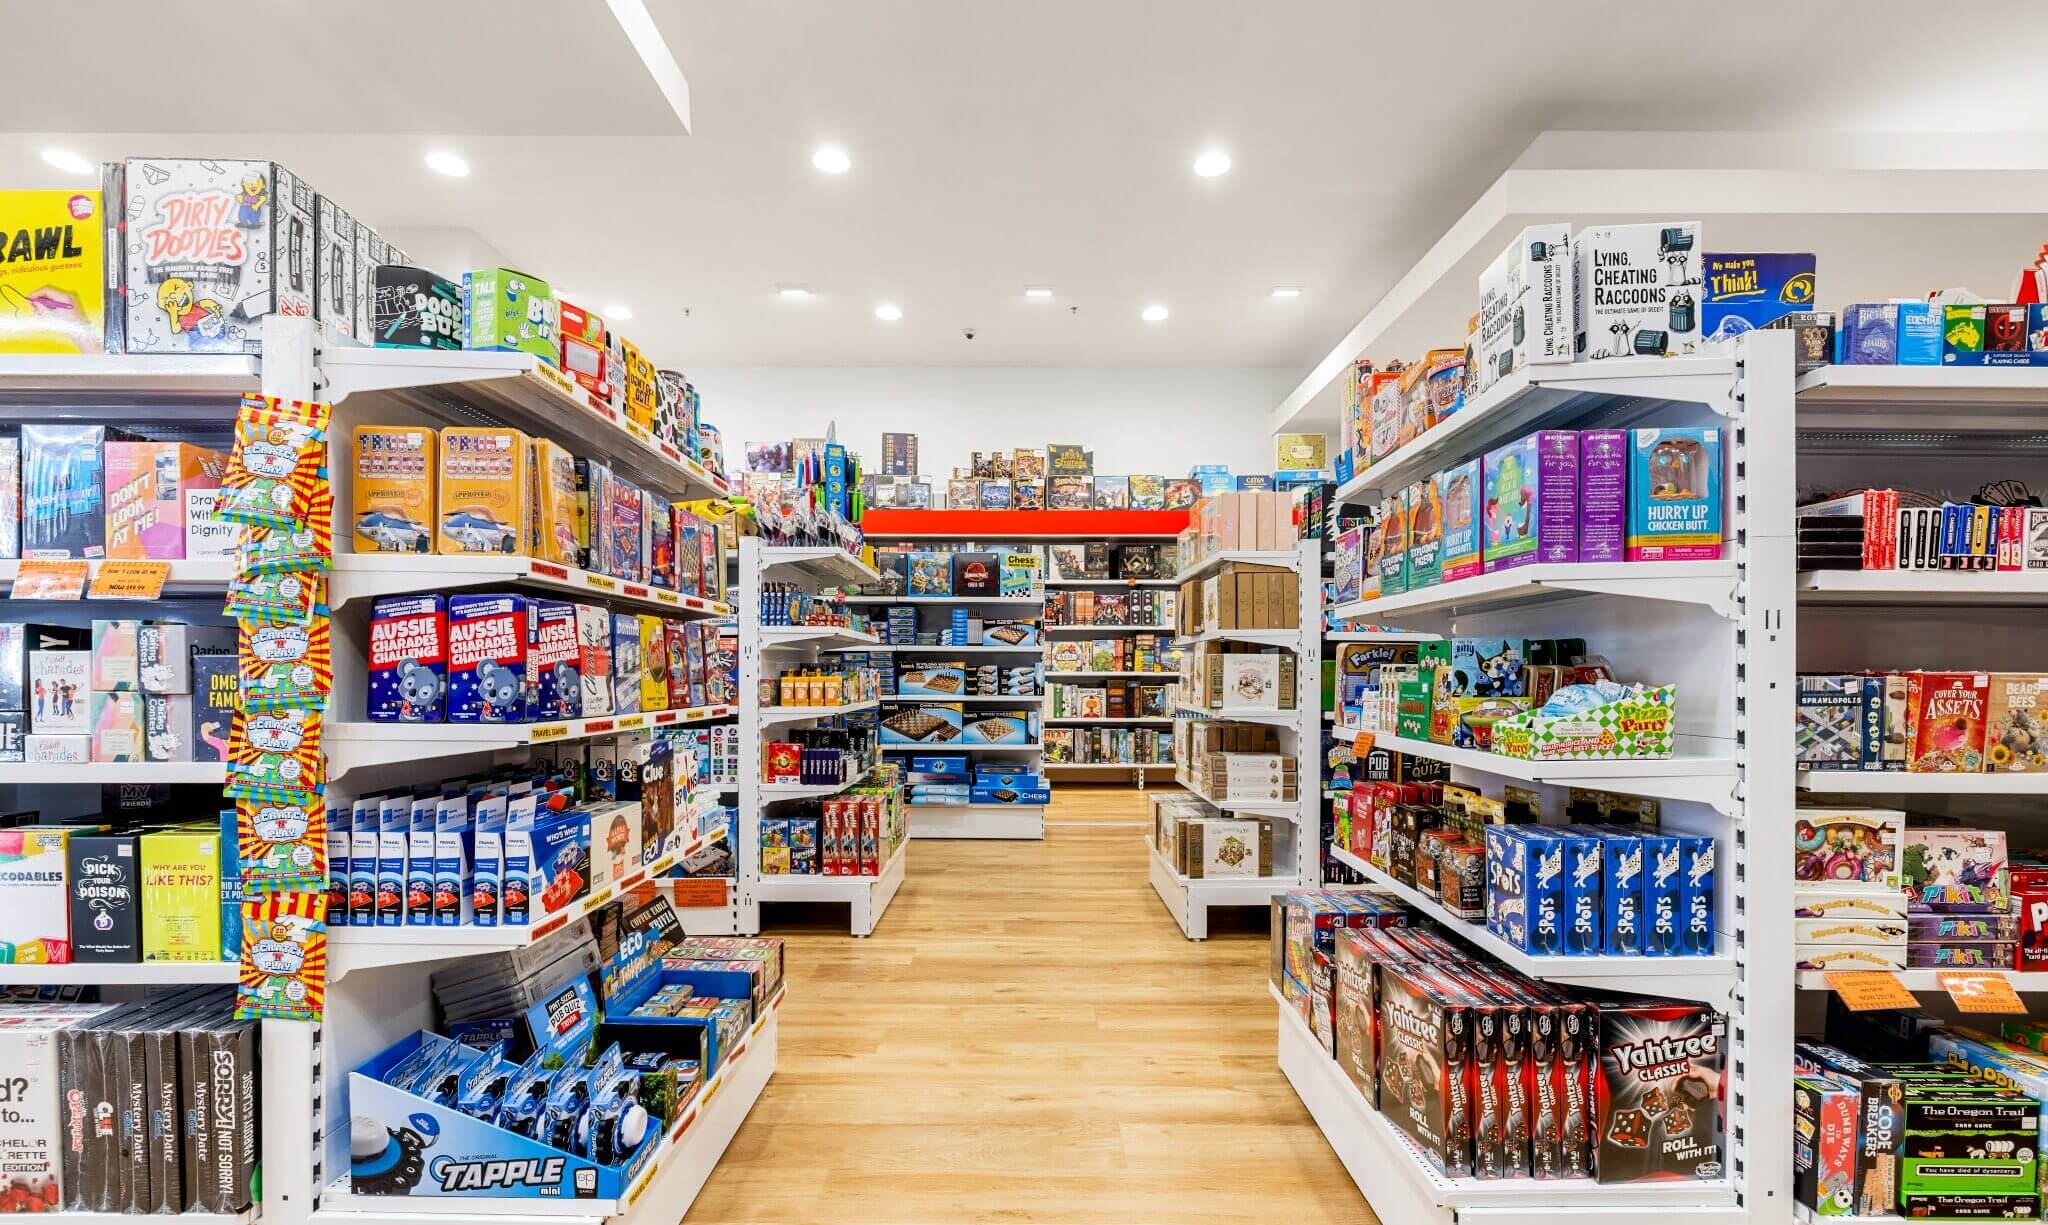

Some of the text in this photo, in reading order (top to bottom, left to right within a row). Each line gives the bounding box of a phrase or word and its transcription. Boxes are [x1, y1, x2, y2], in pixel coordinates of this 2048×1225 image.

[162, 194, 229, 229] DIRTY
[147, 228, 242, 260] DOODLES
[1712, 259, 1756, 271] We make you
[1594, 268, 1657, 286] CHEATING
[1711, 271, 1758, 294] Think!
[1543, 264, 1554, 335] CHEATING RACCOONS
[1594, 287, 1666, 306] RACCOONS
[1246, 476, 1265, 484] CATAN
[111, 472, 150, 507] DON'T
[112, 497, 144, 528] LOOK
[1648, 505, 1708, 520] HURRY UP
[191, 525, 233, 537] Dignity
[1648, 520, 1684, 531] CHICKEN
[113, 526, 129, 548] AT
[1008, 556, 1034, 564] Chess
[251, 630, 309, 644] SCRATCH
[372, 617, 436, 641] AUSSIE
[450, 617, 514, 642] AUSSIE
[372, 634, 438, 653] CHARADES
[451, 634, 516, 653] CHARADES
[266, 648, 296, 659] PLAY
[373, 645, 439, 664] CHALLENGE
[452, 646, 518, 665] CHALLENGE
[1350, 647, 1397, 668] Farkle!
[211, 674, 237, 690] OMG
[2006, 683, 2040, 695] BEARS
[1801, 697, 1862, 705] SPRAWLOPOLIS
[1934, 690, 1978, 700] COVER YOUR
[2008, 695, 2037, 708] BEES
[149, 698, 158, 736] Contest
[1622, 706, 1668, 720] Pizza
[1925, 698, 1983, 720] ASSETS
[248, 718, 304, 736] SCRATCH
[532, 727, 567, 737] TRAVEL GAMES
[1620, 718, 1667, 734] Party
[259, 738, 288, 749] PLAY
[1369, 756, 1389, 771] PUB
[1412, 763, 1441, 778] QUIZ
[642, 764, 664, 784] Clue
[254, 811, 309, 824] SCRATCH
[268, 829, 297, 839] PLAY
[546, 830, 564, 843] WHO'S
[0, 872, 62, 881] CODABLES
[87, 863, 116, 875] PICK
[146, 875, 213, 886] LIKE THIS?
[80, 886, 126, 898] POISON
[584, 897, 599, 912] TRAVEL
[252, 944, 305, 959] SCRATCH
[619, 931, 643, 961] ECO
[265, 961, 292, 971] PLAY
[551, 1000, 581, 1027] PUB QUIZ
[560, 1014, 578, 1031] TRIVIA
[1385, 1001, 1438, 1044] Yahtzee
[1397, 1029, 1424, 1051] CLASSIC
[1613, 1033, 1717, 1074] Yahtzee
[1638, 1062, 1690, 1082] CLASSIC
[1480, 1074, 1494, 1118] Yahtzee
[1537, 1073, 1551, 1117] Yahtzee
[2, 1109, 35, 1123] to...
[1410, 1107, 1429, 1128] ROLL
[1922, 1106, 2026, 1118] The Oregon Trail
[132, 1083, 144, 1162] Mystery Date
[162, 1082, 174, 1162] Mystery Date
[195, 1081, 207, 1162] Mystery Date
[214, 1051, 235, 1194] SORRY! NOT SORRY!
[1865, 1097, 1879, 1158] BREAKERS
[1877, 1104, 1892, 1150] CODE
[1826, 1123, 1835, 1144] DIE
[1835, 1101, 1852, 1167] DUMB WAYS
[1663, 1137, 1697, 1153] ROLL
[1676, 1149, 1702, 1161] WITH
[441, 1157, 566, 1191] TAPPLE
[540, 1186, 561, 1196] mini
[1957, 1197, 1985, 1205] Oregon
[1986, 1196, 2008, 1204] Trail
